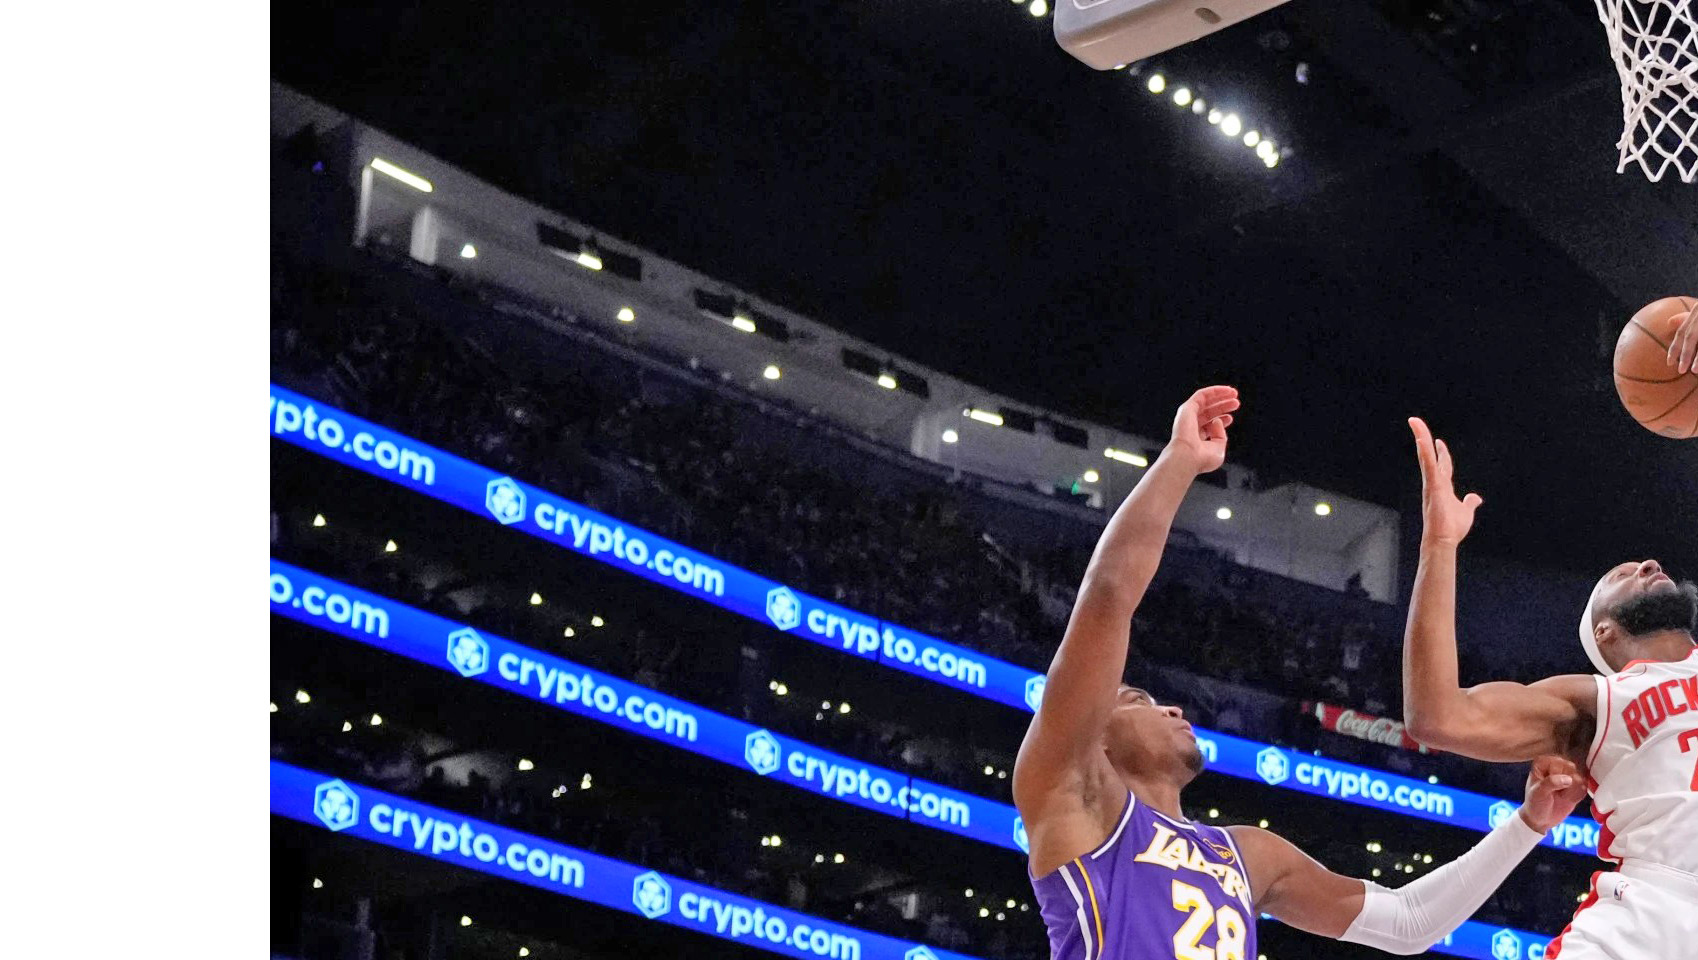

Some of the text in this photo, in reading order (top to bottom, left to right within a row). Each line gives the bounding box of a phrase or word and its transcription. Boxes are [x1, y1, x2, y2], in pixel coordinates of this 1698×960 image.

[535, 503, 724, 595] crypto.com
[808, 609, 986, 687] crypto.com
[499, 653, 697, 740] crypto.com
[788, 752, 969, 827] crypto.com
[1295, 762, 1453, 816] crypto.com
[370, 805, 584, 887] crypto.com
